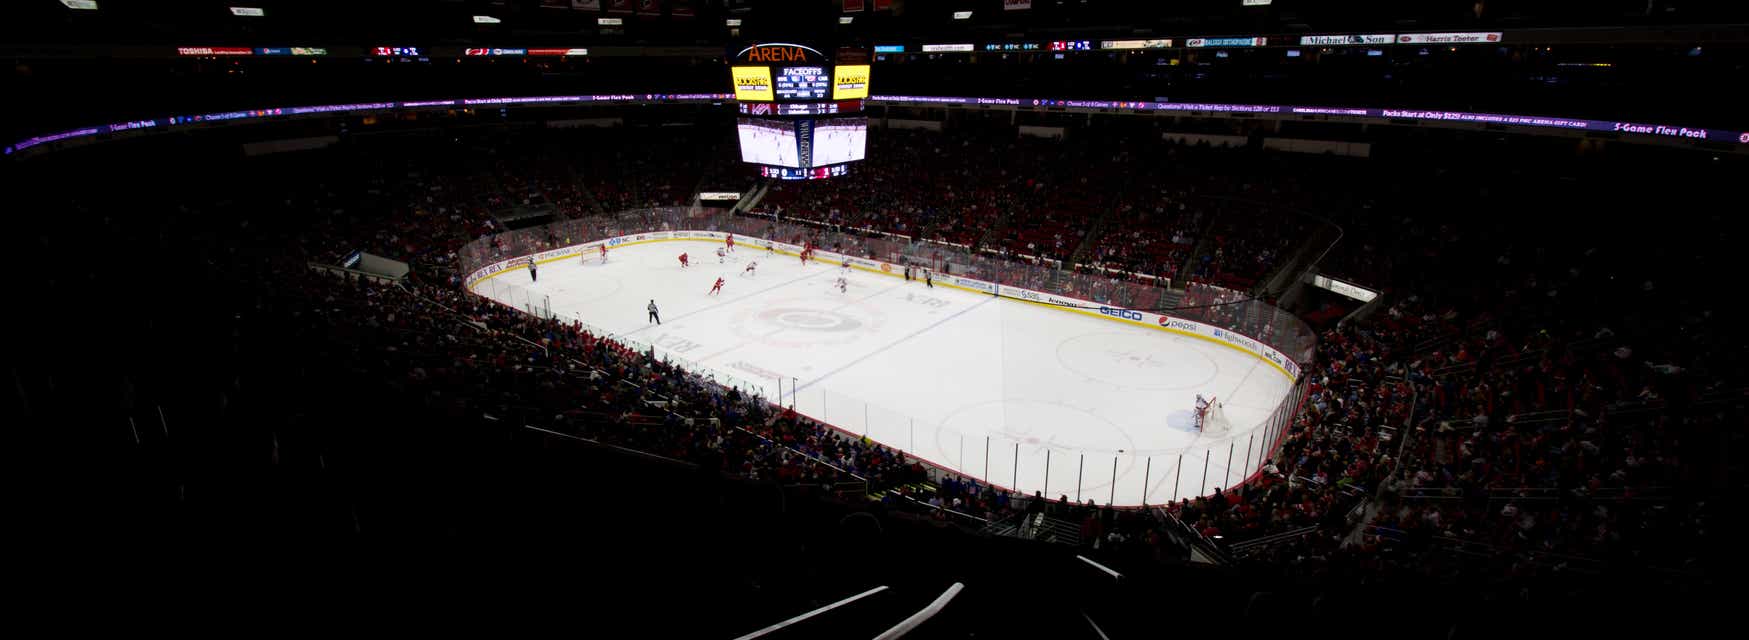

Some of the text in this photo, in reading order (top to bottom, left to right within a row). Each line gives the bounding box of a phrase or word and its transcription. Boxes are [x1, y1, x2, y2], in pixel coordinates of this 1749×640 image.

[1309, 36, 1346, 44] Michael
[178, 47, 213, 55] TOSHIBA
[749, 44, 807, 62] ARENA
[783, 68, 822, 76] FACEOFFS
[1655, 125, 1677, 135] Flex
[1679, 128, 1707, 138] Pack
[1100, 306, 1142, 321] GEICO
[1171, 321, 1197, 331] pepsi
